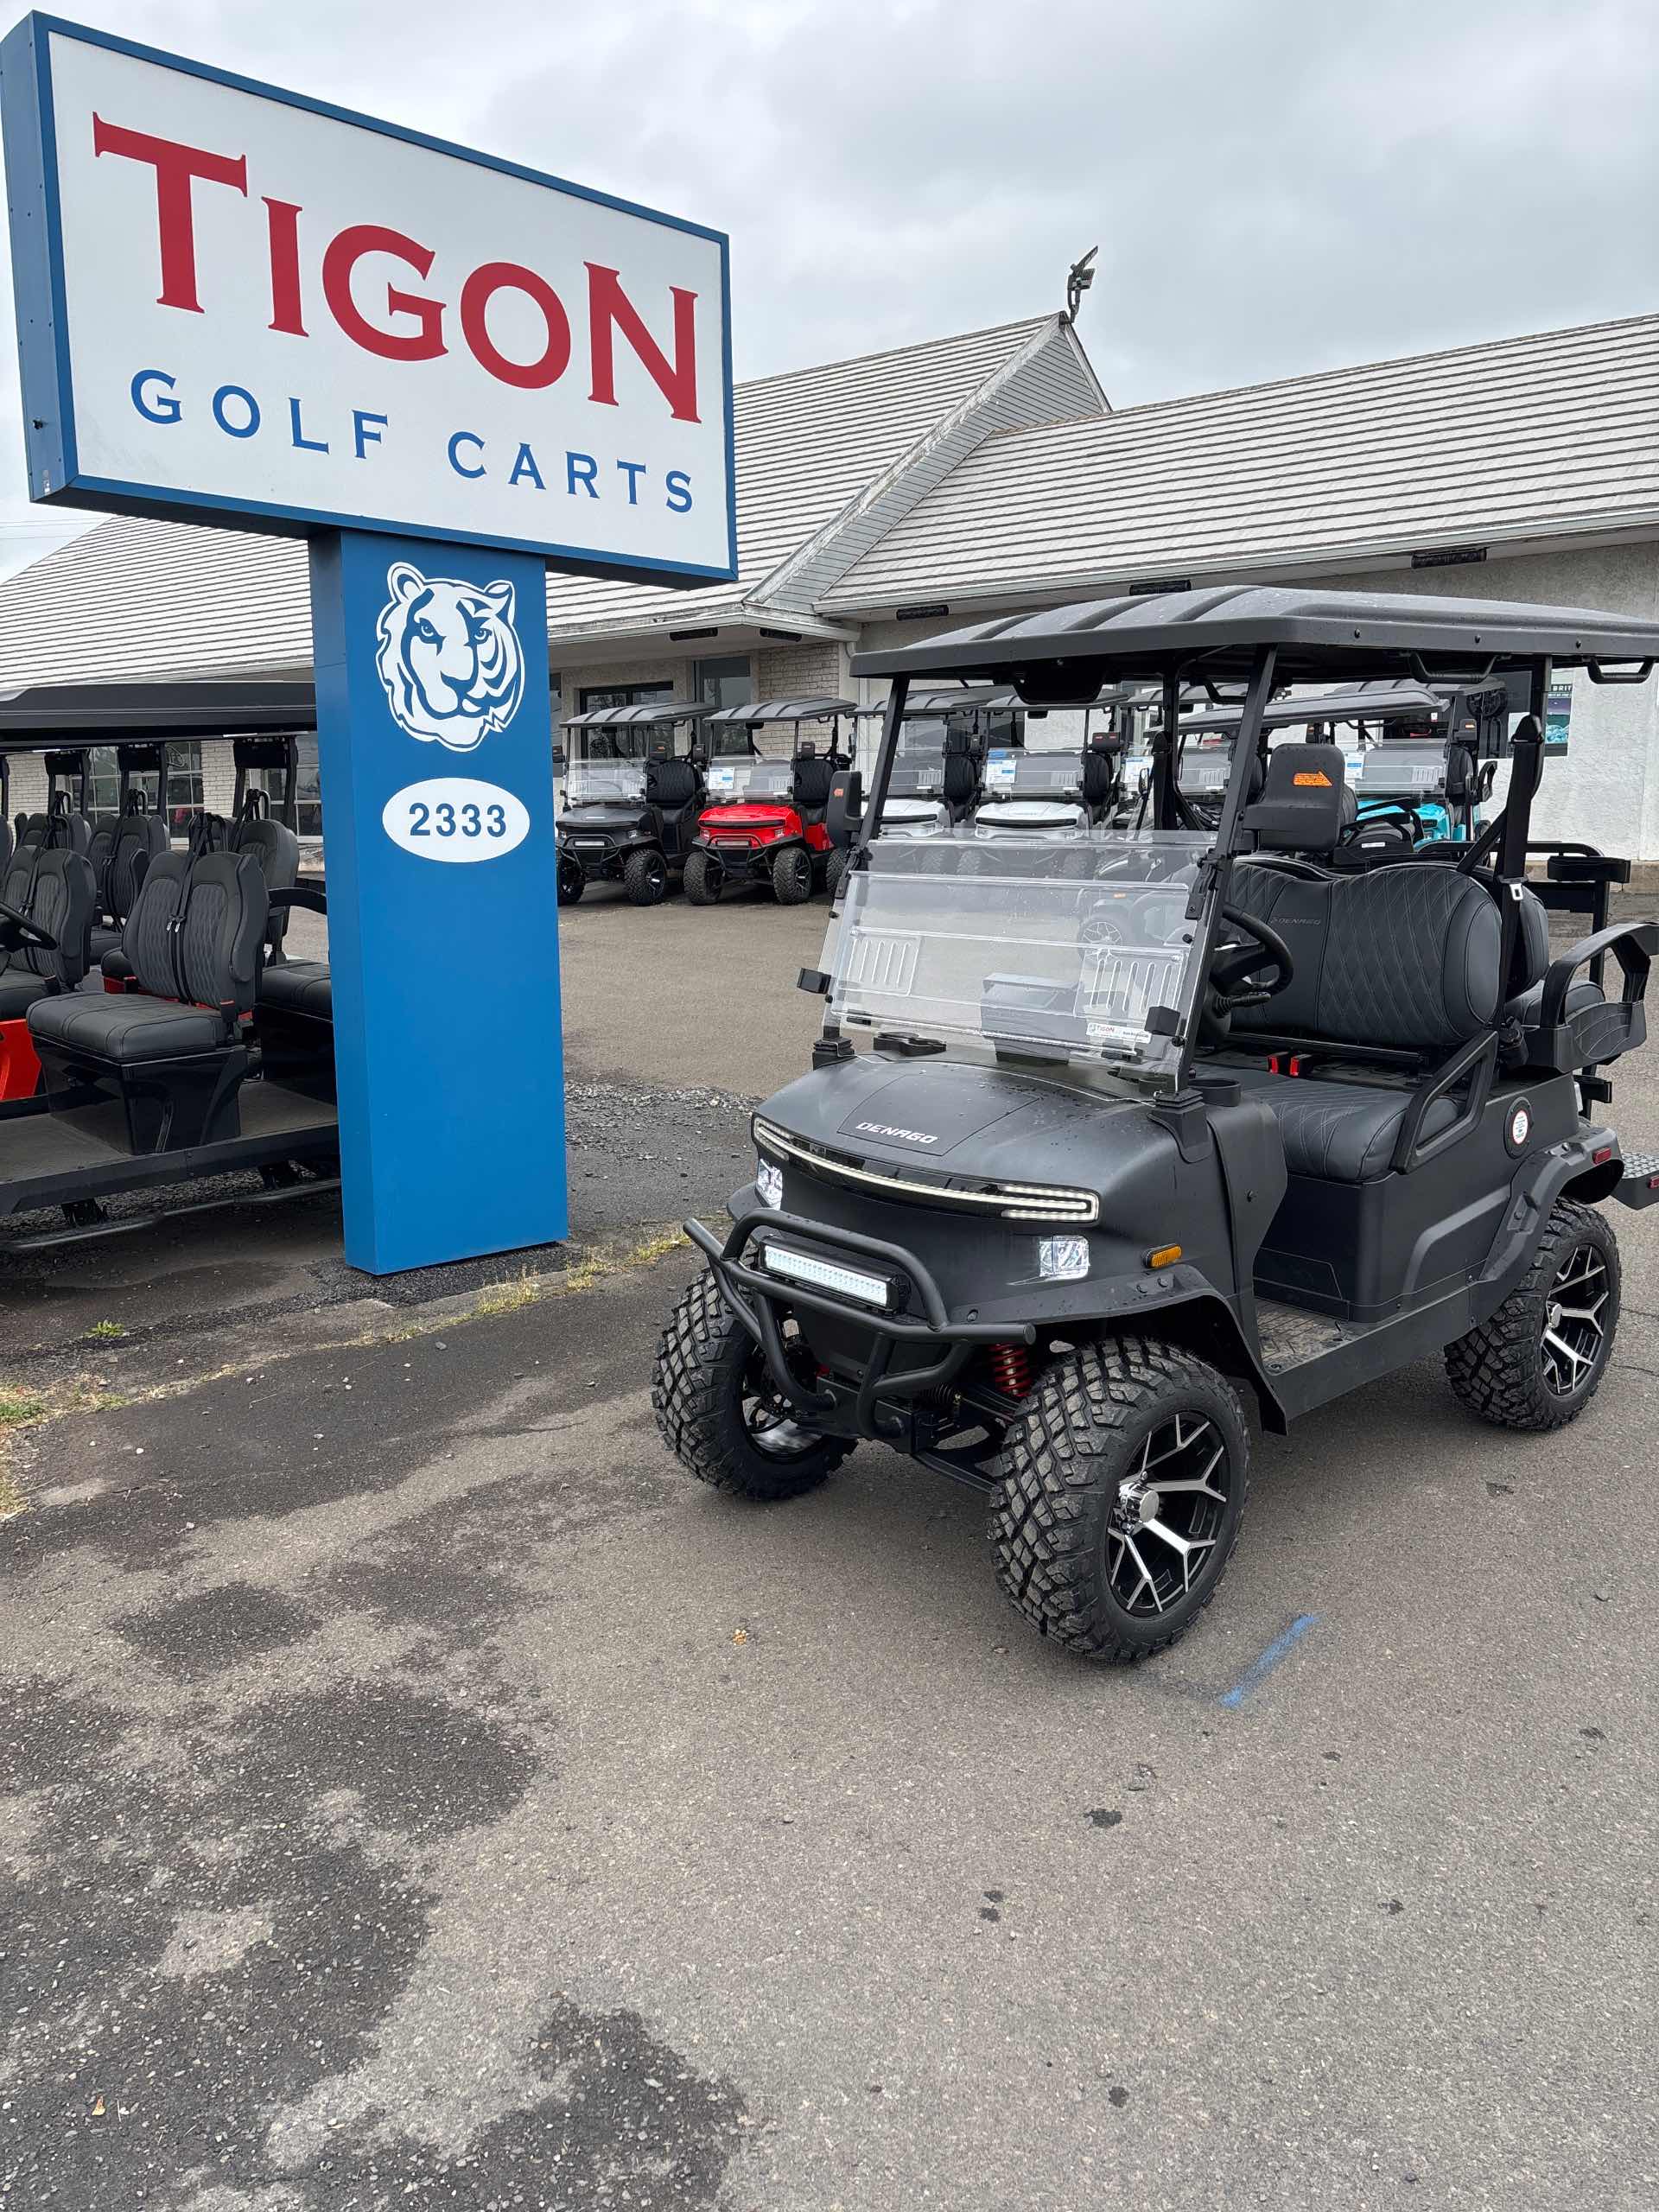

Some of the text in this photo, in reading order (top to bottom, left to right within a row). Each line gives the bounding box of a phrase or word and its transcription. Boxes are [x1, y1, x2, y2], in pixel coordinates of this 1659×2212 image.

[94, 111, 702, 423] TIGON
[130, 369, 693, 513] GOLF CARTS
[409, 802, 507, 838] 2333
[855, 1122, 938, 1143] DENAGO
